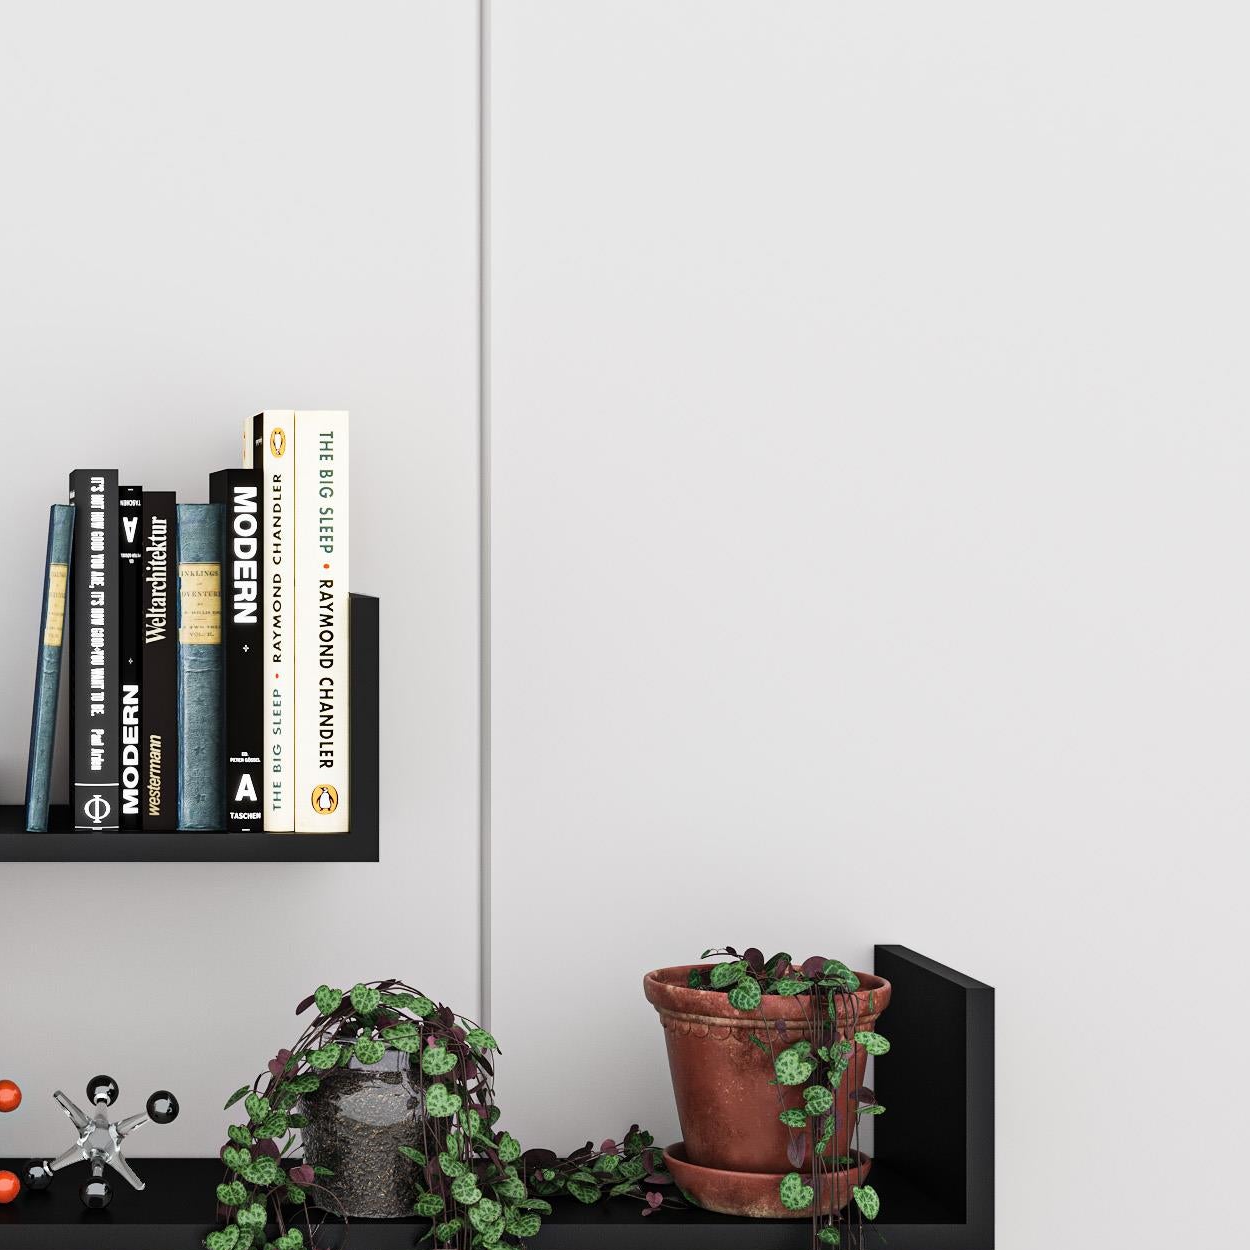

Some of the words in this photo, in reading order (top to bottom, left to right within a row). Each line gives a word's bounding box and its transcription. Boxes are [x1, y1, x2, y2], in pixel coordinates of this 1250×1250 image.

[319, 431, 334, 461] THE
[90, 477, 105, 492] IT'S
[319, 469, 334, 499] BIG
[122, 517, 138, 543] A
[272, 474, 282, 565] CHANDLER
[319, 506, 334, 554] SLEEP
[233, 486, 257, 624] MODERN
[146, 515, 167, 644] Weltarchitektur
[272, 573, 282, 663] RAYMOND
[319, 579, 334, 669] RAYMOND
[272, 688, 282, 735] SLEEP
[319, 677, 334, 769] CHANDLER
[123, 684, 139, 815] MODERN
[272, 743, 282, 773] BIG
[148, 734, 162, 817] westermann
[234, 773, 258, 802] A
[272, 780, 282, 811] THE
[229, 811, 261, 820] TASCHEN
